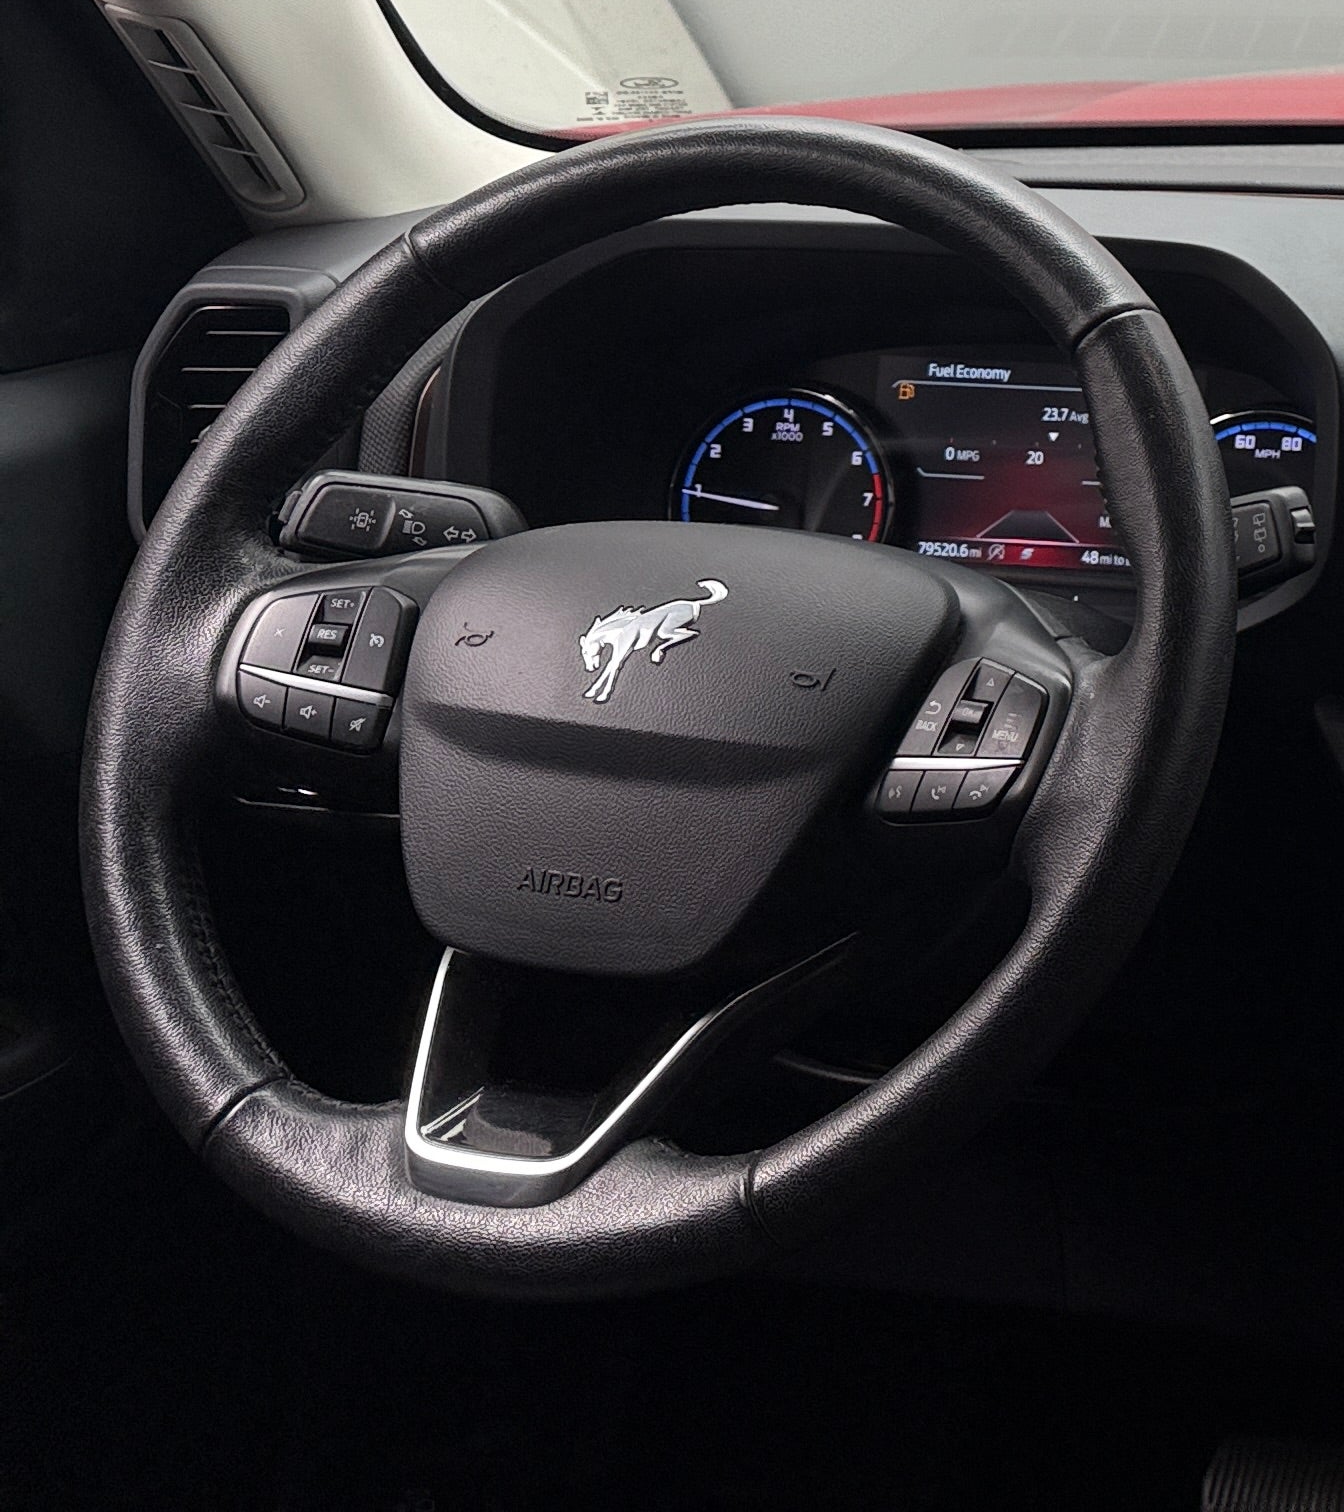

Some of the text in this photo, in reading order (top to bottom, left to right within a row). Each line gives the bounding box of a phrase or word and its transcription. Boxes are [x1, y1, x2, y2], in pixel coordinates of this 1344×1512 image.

[928, 363, 1011, 382] Fuel Economy
[783, 409, 794, 422] 4
[1042, 407, 1089, 424] 23.7 Avg
[743, 418, 753, 432] 3
[775, 422, 800, 432] RPM
[822, 423, 834, 436] 5
[771, 431, 803, 441] x1000
[1235, 435, 1256, 449] 60
[710, 444, 721, 458] 2
[1281, 437, 1302, 451] 80
[852, 451, 862, 465] 6
[945, 447, 980, 462] 0 MPG
[1026, 451, 1044, 466] 20
[1255, 449, 1280, 459] MPH
[863, 492, 873, 507] 7
[918, 542, 982, 557] 79520.6 mi
[1081, 551, 1124, 566] 48 mi to
[330, 598, 355, 608] SET+
[317, 629, 337, 640] RES
[308, 665, 334, 673] SET-
[915, 720, 938, 731] BACK
[992, 730, 1018, 742] MENU
[517, 866, 624, 903] AIRBAG
